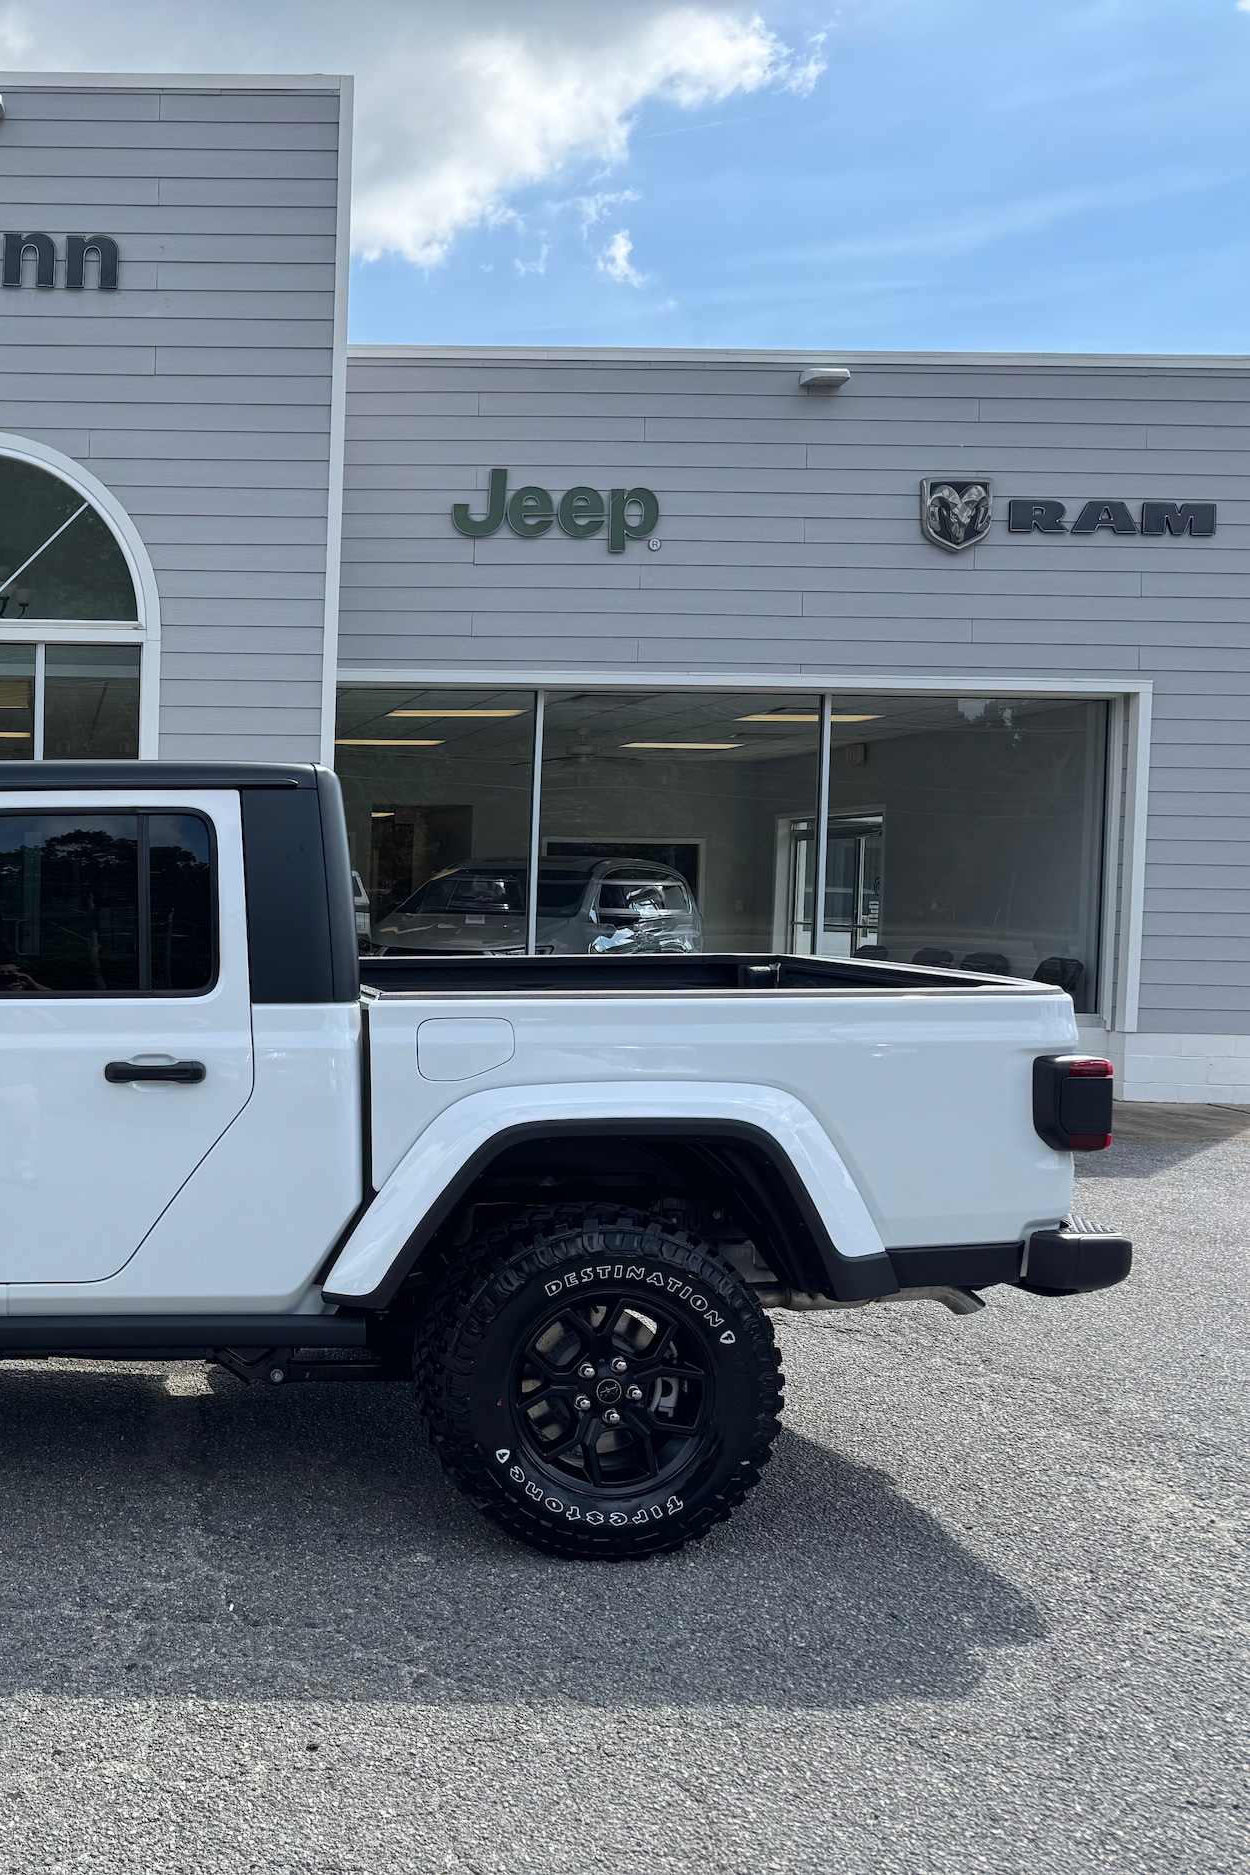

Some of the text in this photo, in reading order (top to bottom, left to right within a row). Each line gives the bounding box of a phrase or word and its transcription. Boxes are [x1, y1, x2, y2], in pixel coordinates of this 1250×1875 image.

[452, 468, 659, 553] Jeep
[1008, 500, 1217, 536] RAM
[544, 1265, 724, 1328] DESTINATION
